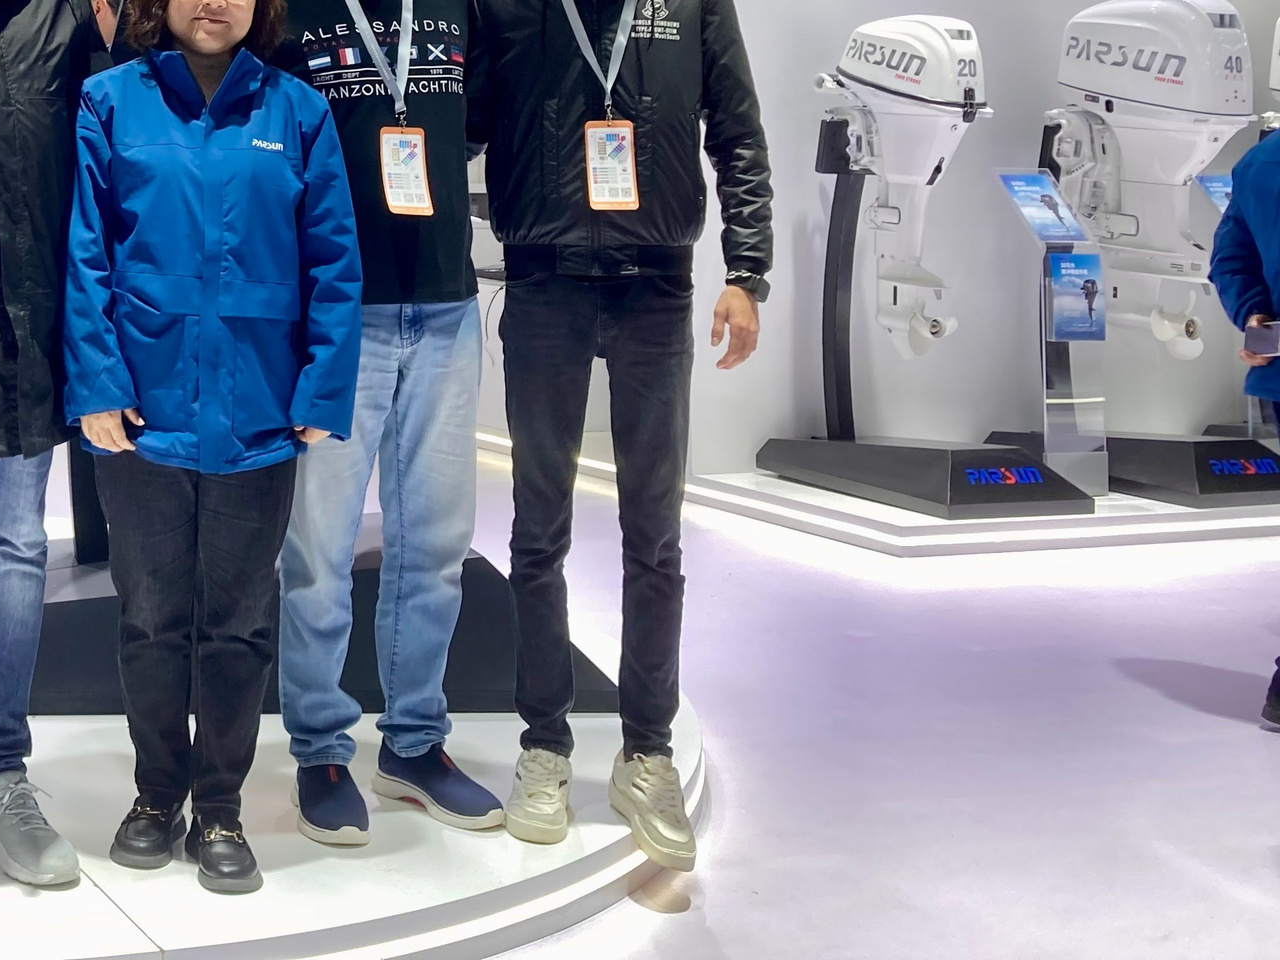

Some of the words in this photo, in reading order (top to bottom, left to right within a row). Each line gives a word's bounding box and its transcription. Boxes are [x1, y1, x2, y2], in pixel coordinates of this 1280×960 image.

[845, 38, 927, 77] PARSUN
[1065, 36, 1188, 78] PARSUN
[1223, 55, 1243, 74] 40
[957, 58, 978, 78] 20
[321, 82, 392, 100] ANZON
[408, 80, 464, 95] ACHTING
[251, 138, 284, 152] PARSUN
[964, 466, 1044, 485] PARSUN
[1209, 458, 1280, 476] PARSUN
